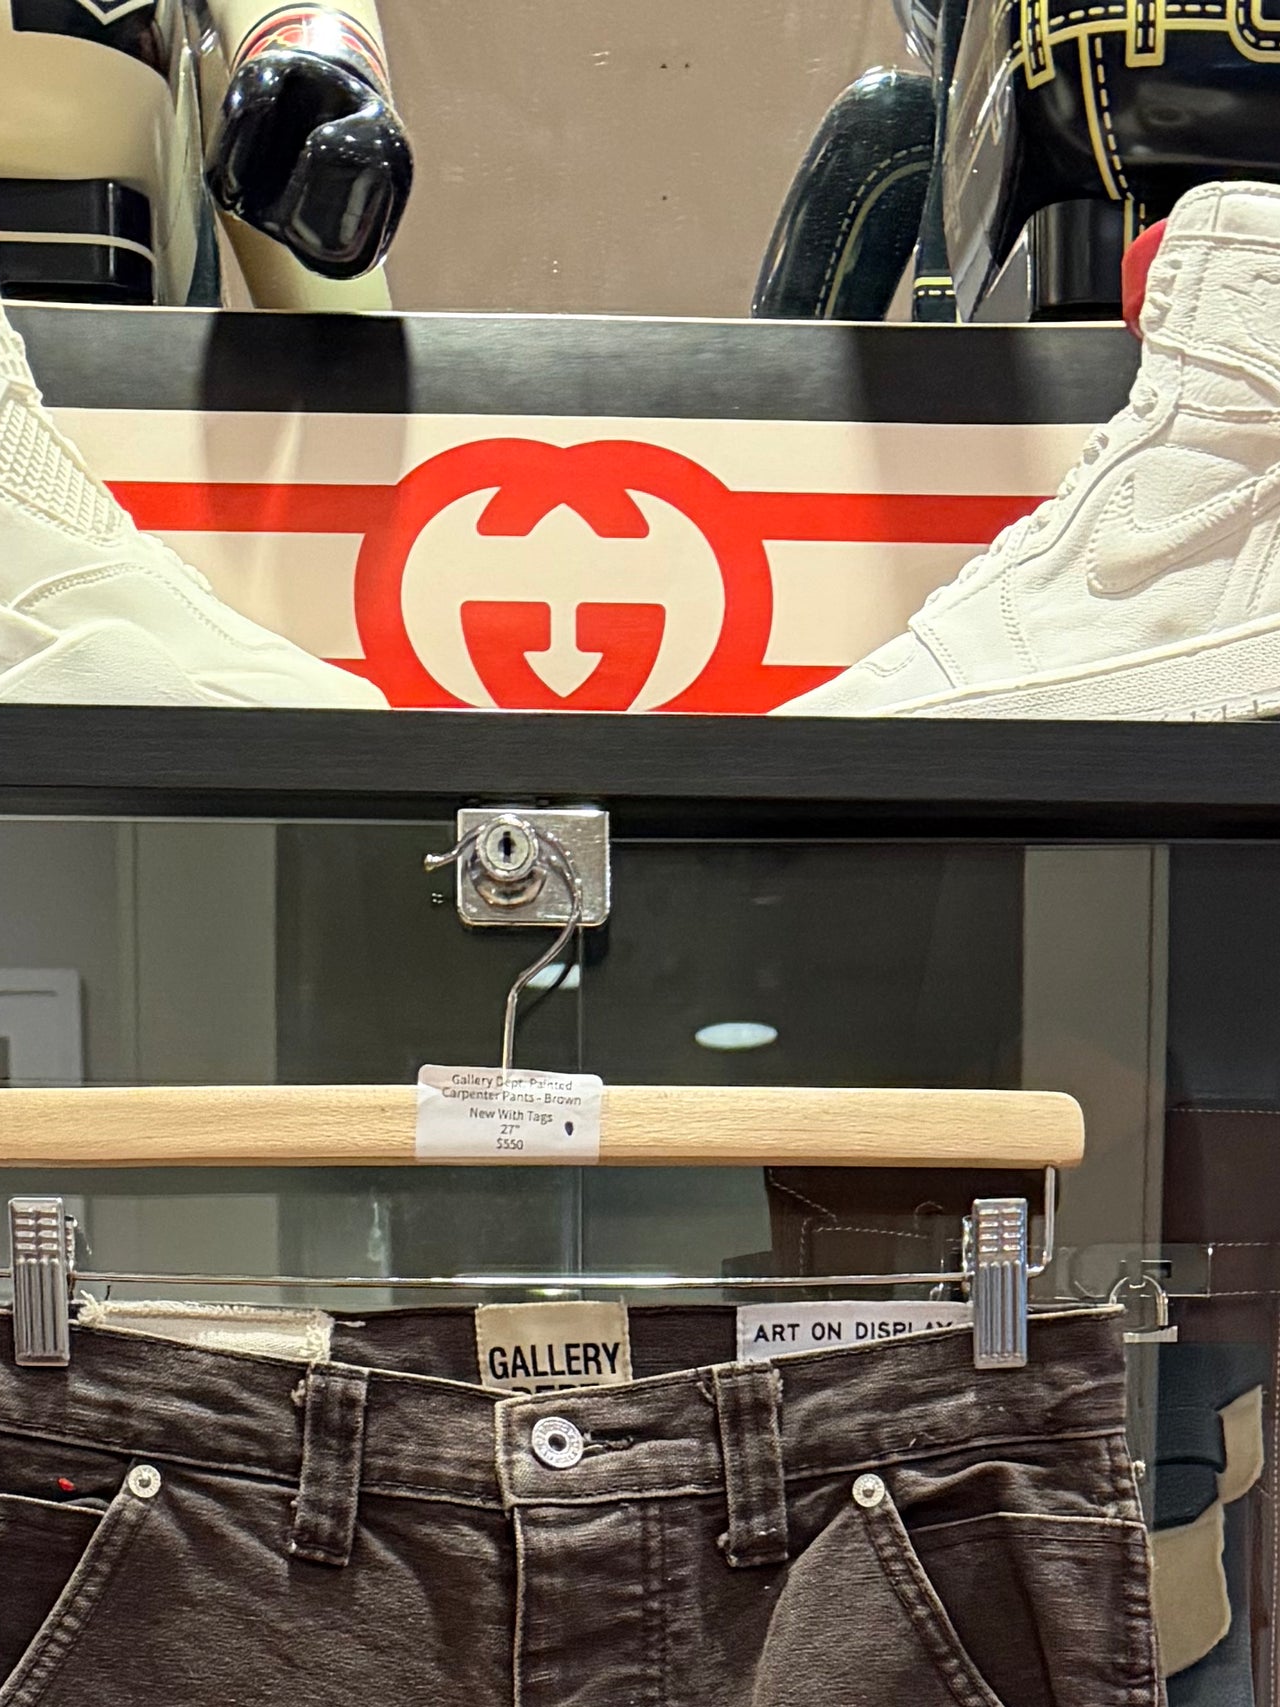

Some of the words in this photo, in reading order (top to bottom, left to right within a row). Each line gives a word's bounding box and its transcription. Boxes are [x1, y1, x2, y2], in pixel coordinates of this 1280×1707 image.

[452, 1073, 494, 1089] Gallery
[529, 1077, 573, 1091] Painted
[441, 1086, 500, 1101] Carpenter
[502, 1089, 535, 1103] Pants
[544, 1092, 582, 1106] Brown
[469, 1107, 495, 1119] New
[498, 1108, 524, 1121] With
[527, 1110, 553, 1125] Tags
[496, 1137, 524, 1150] $550
[754, 1323, 801, 1343] ART
[811, 1321, 842, 1341] ON
[488, 1341, 620, 1380] GALLERY
